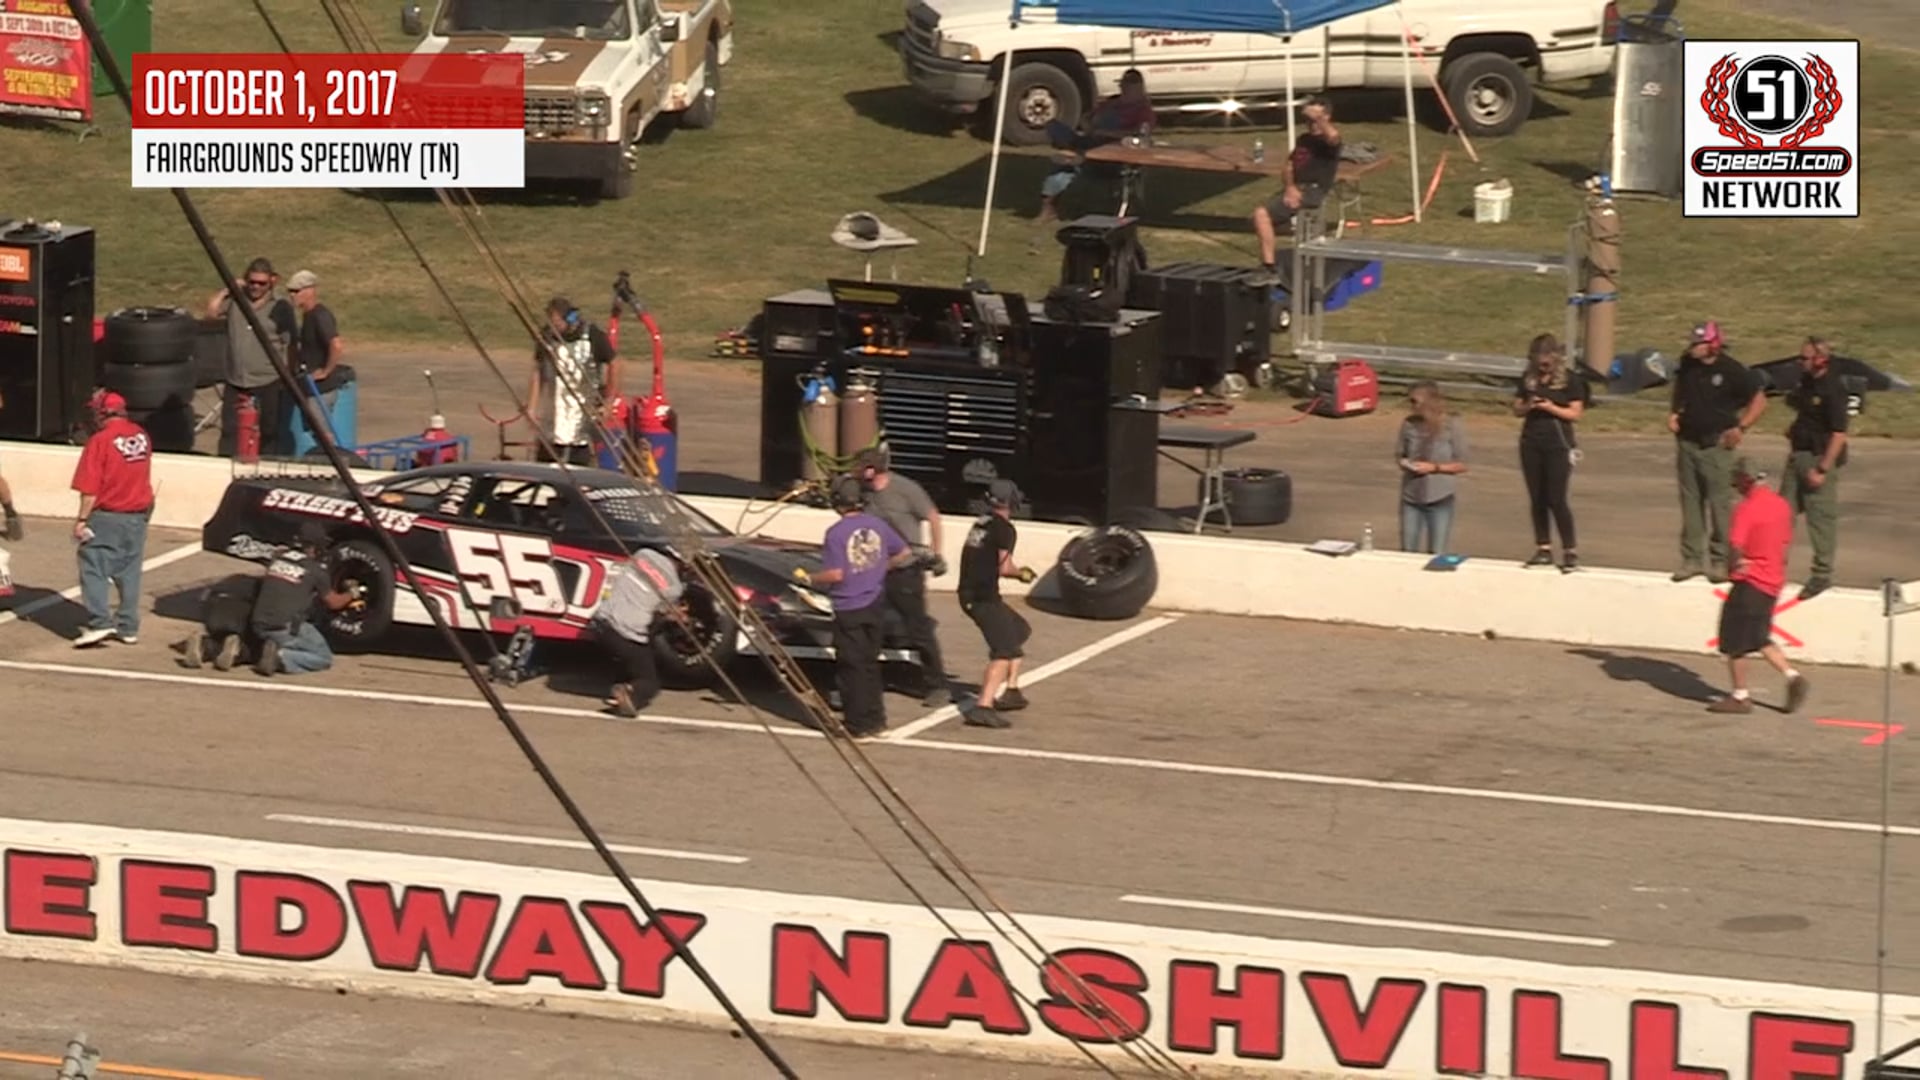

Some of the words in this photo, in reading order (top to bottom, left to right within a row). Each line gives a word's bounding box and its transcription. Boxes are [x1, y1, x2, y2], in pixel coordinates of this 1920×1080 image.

[262, 487, 359, 518] STREET
[447, 527, 567, 615] 55
[4, 848, 706, 998] EEDWAY
[771, 924, 1855, 1080] NASHVILLE
